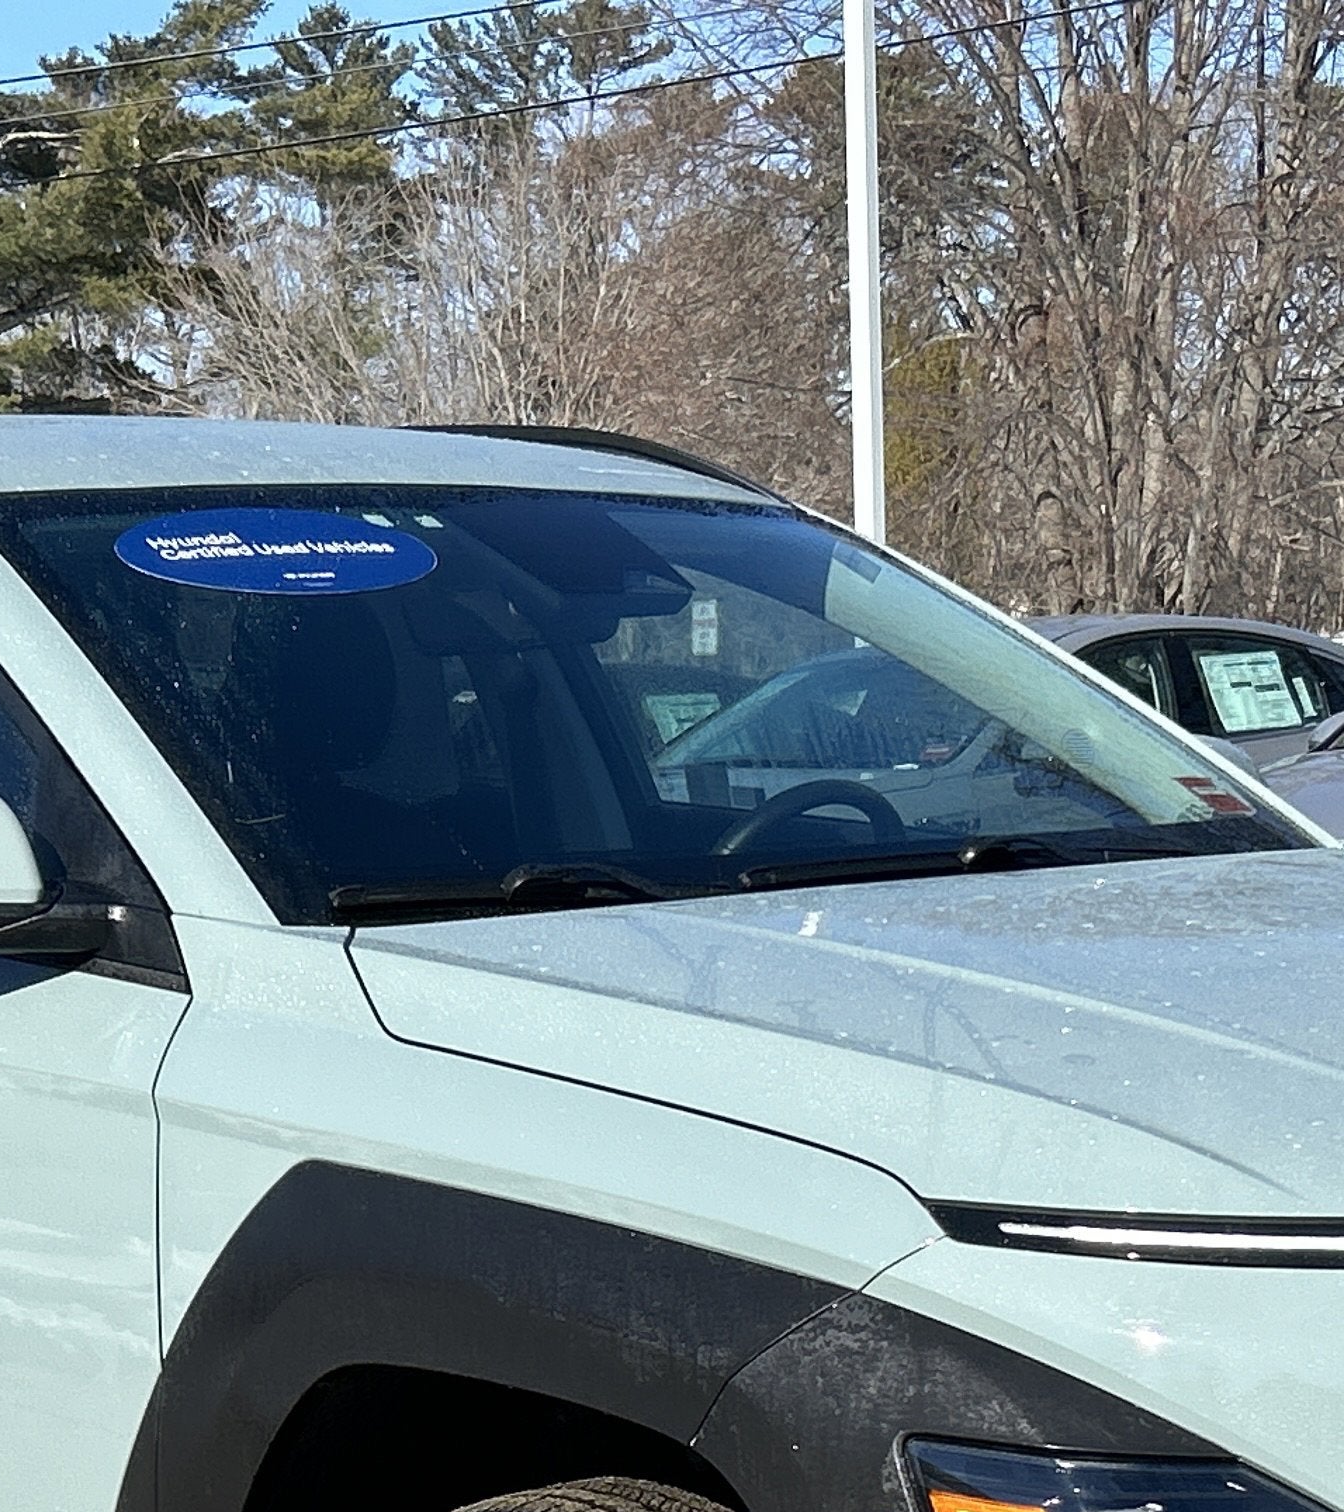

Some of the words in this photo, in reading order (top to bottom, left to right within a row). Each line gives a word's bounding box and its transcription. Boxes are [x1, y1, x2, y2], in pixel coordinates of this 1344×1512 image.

[145, 531, 243, 551] Hyundai
[159, 543, 255, 561] Certified
[251, 540, 311, 555] Used
[304, 539, 396, 554] Vehicles
